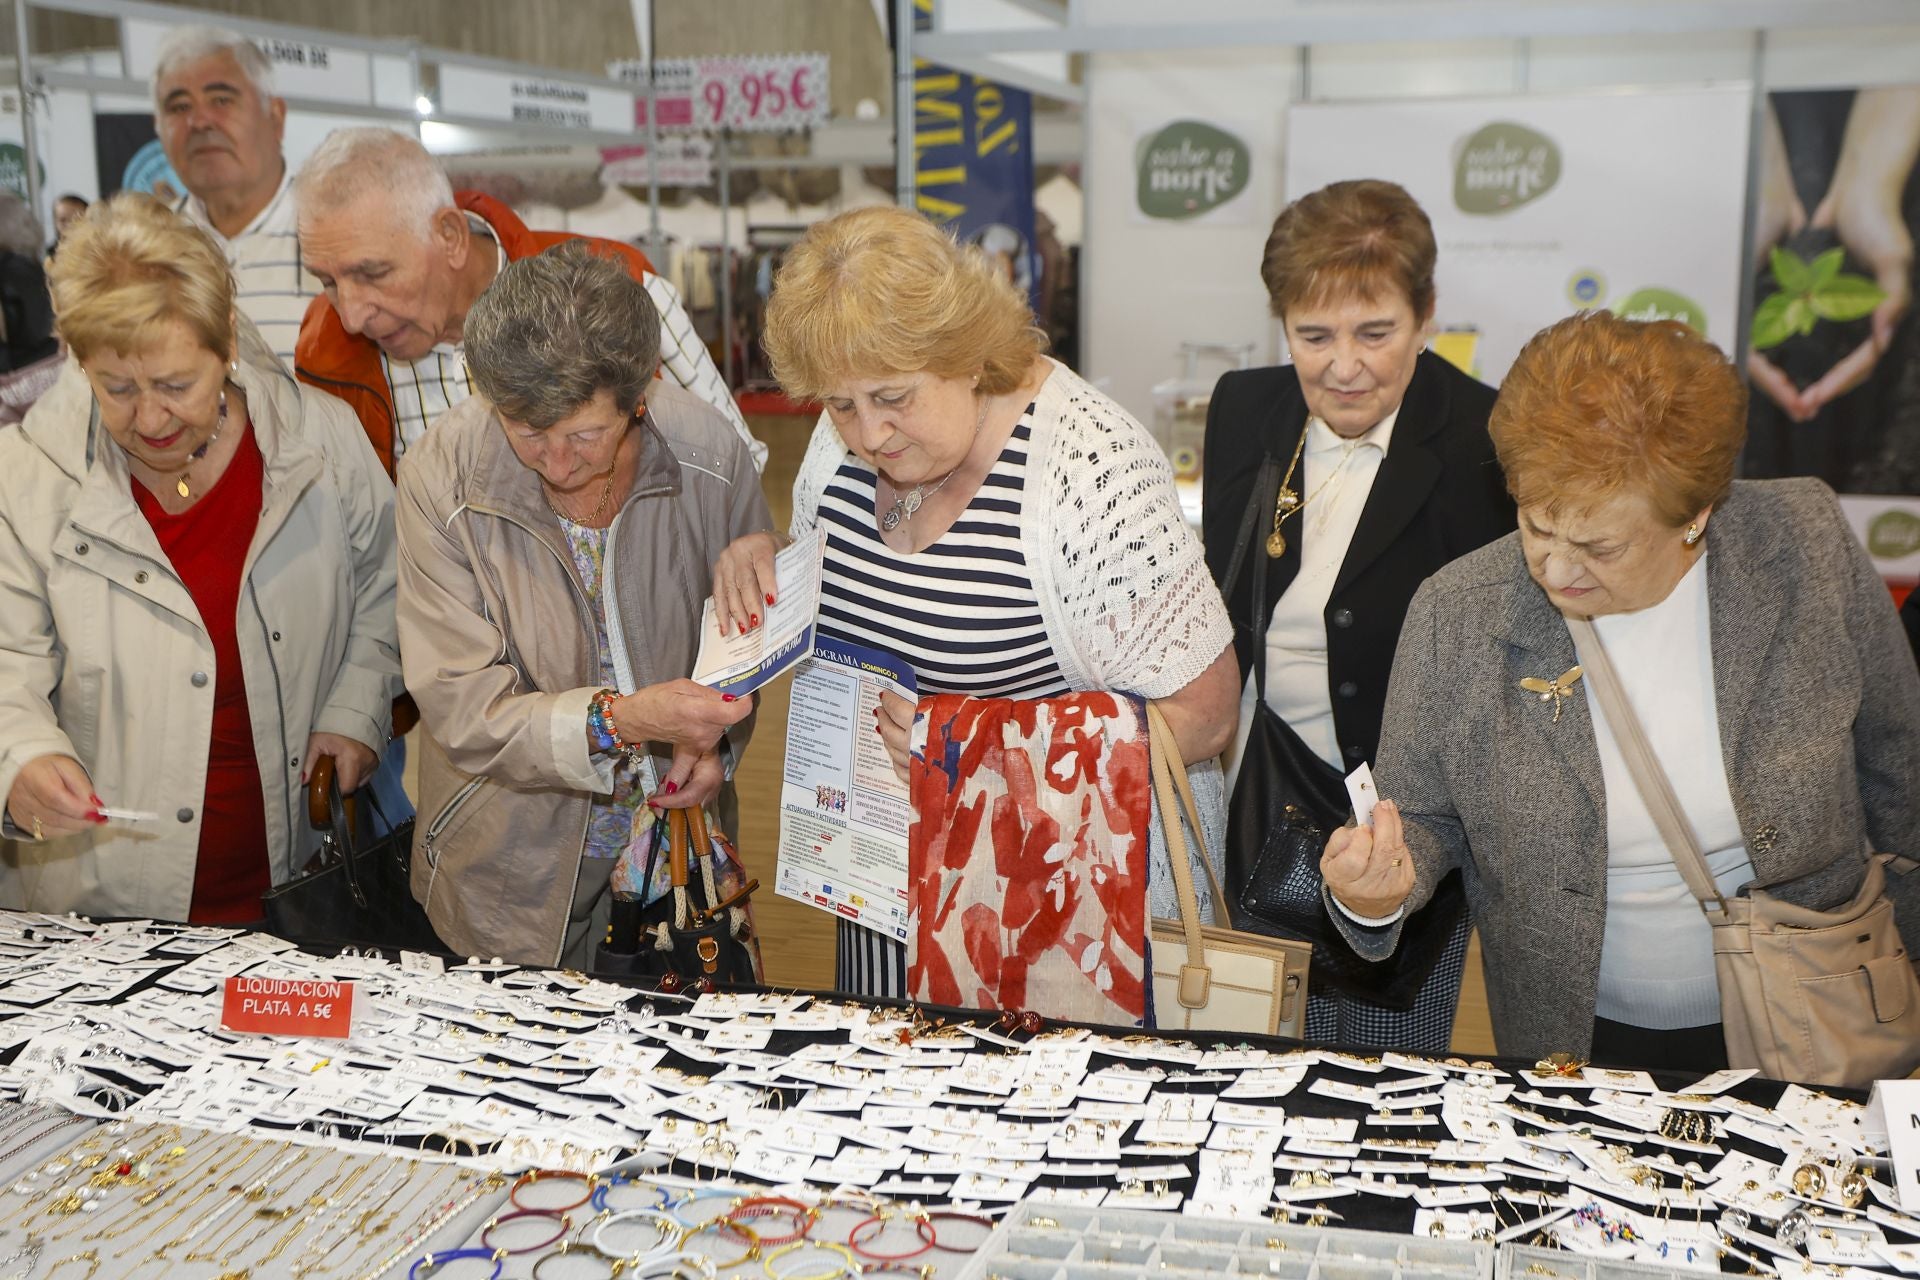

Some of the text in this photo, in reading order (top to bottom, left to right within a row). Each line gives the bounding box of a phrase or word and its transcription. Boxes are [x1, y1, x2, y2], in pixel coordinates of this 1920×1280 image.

[812, 648, 858, 667] OGRAMA
[861, 662, 891, 676] DOMINGO
[785, 803, 816, 819] ACTUACIONES
[819, 813, 848, 829] ACTIVIDADES
[242, 998, 332, 1019] PLATA A 5€
